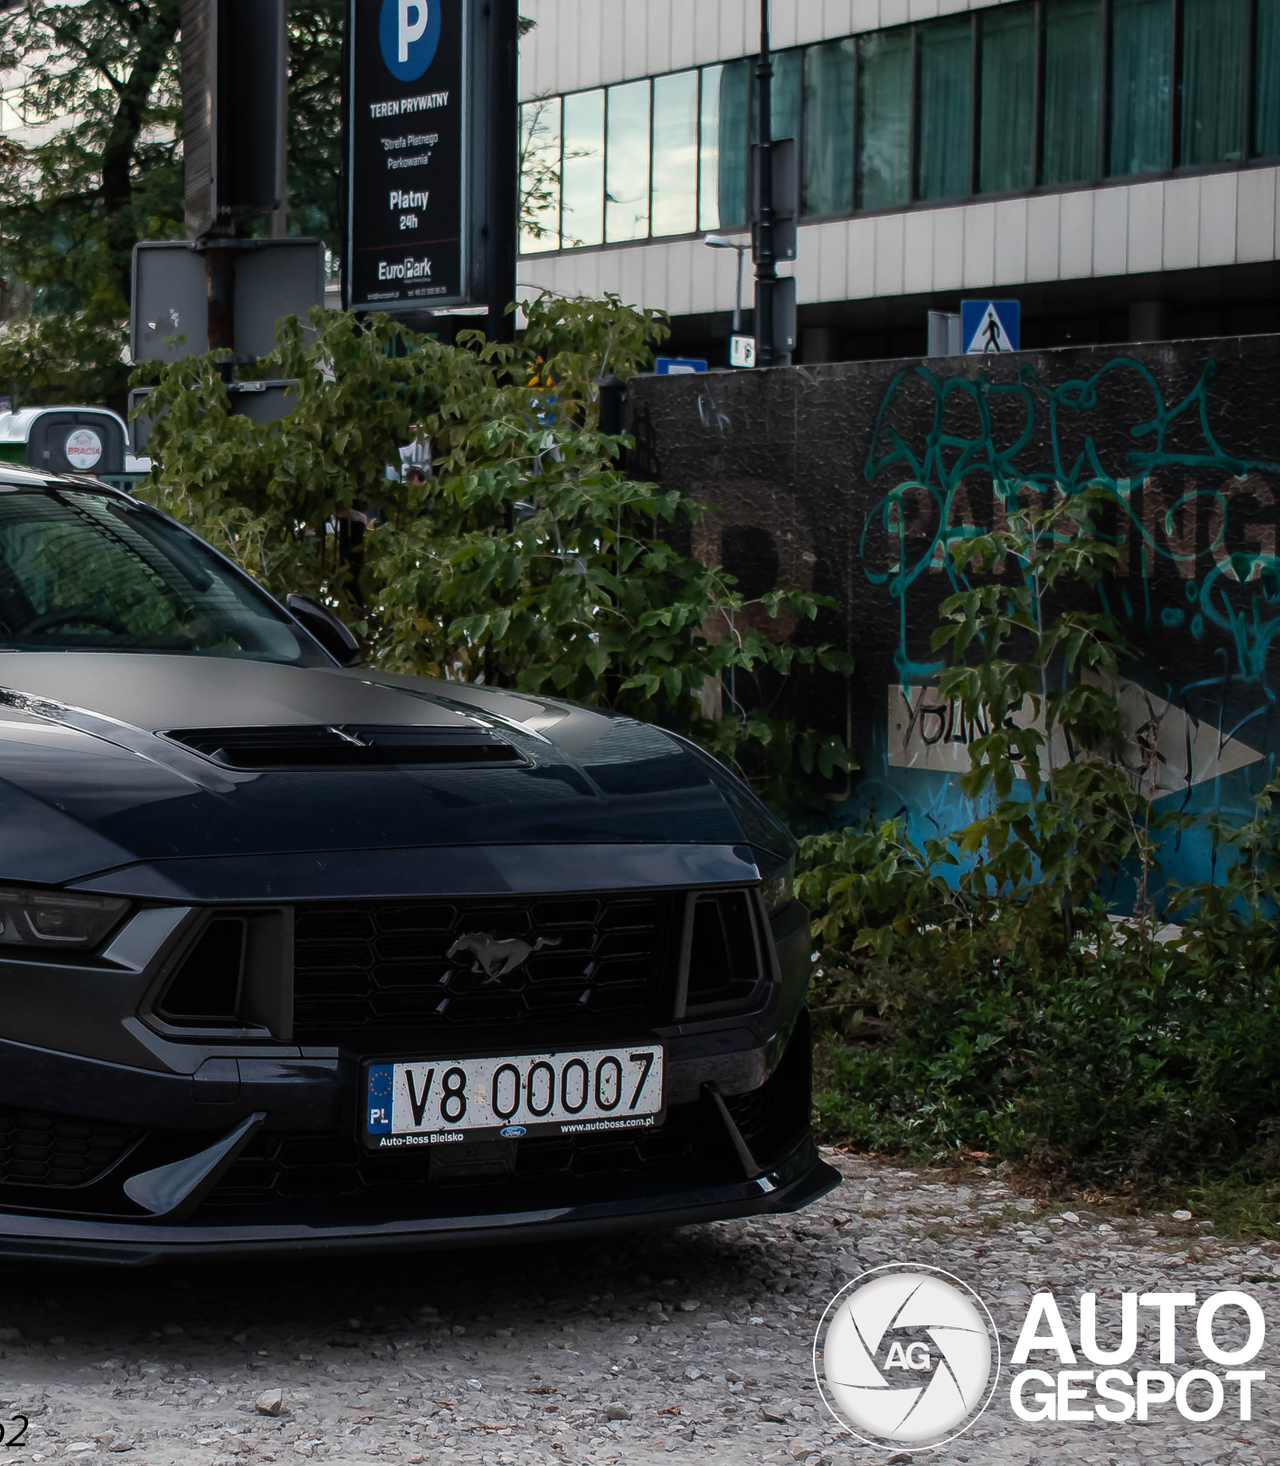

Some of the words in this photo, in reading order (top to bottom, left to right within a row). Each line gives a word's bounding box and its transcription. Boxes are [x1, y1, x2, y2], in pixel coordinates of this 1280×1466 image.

[398, 0, 429, 62] P
[370, 101, 400, 119] TEREN
[401, 91, 449, 115] PRYWATNY
[400, 214, 418, 230] 24h
[378, 257, 432, 280] EuroPark
[886, 475, 1278, 582] PARING
[405, 1066, 468, 1127] V8
[370, 1108, 389, 1125] PL
[560, 1116, 655, 1134] www.autoboss.com.pl
[379, 1135, 429, 1147] Auto-Boss
[430, 1132, 464, 1144] Bielsko
